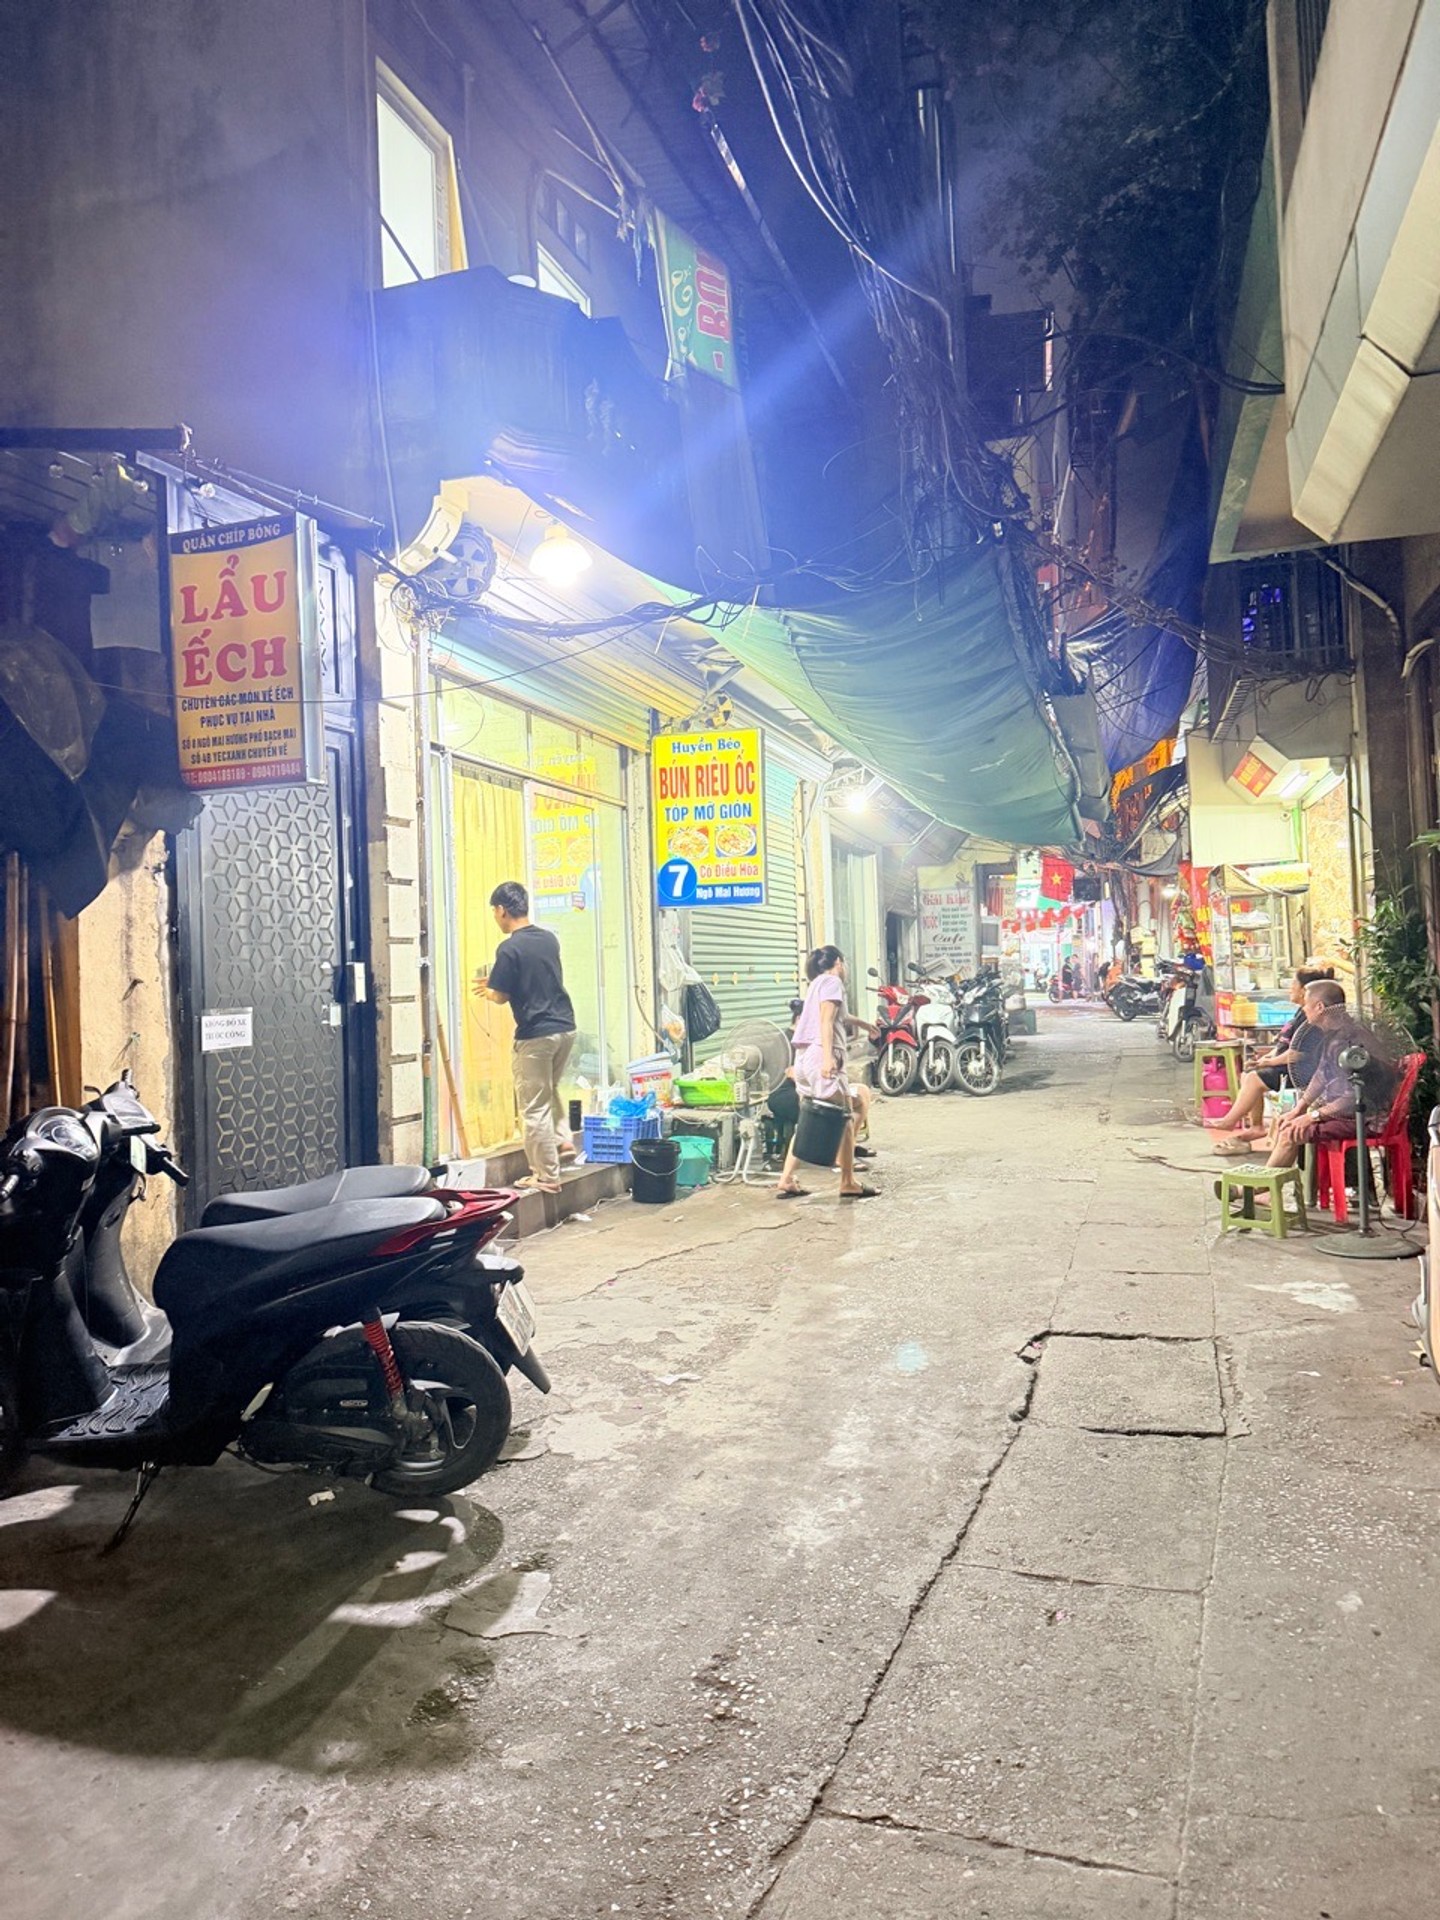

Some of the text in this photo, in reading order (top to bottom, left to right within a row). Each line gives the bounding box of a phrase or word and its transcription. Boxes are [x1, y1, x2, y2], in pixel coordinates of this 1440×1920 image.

[182, 523, 281, 553] QUÁN CHÍP BÔNG
[180, 554, 288, 624] LẨU
[181, 628, 288, 688] ẾCH
[200, 706, 276, 730] PHỤC VỤ TẠI NHÀ
[211, 735, 225, 747] MAI
[283, 728, 297, 739] MAI
[659, 749, 755, 800] BÚN RIÊU ỐC
[664, 803, 689, 822] TÓP
[668, 864, 689, 897] 7
[714, 885, 732, 898] Mai
